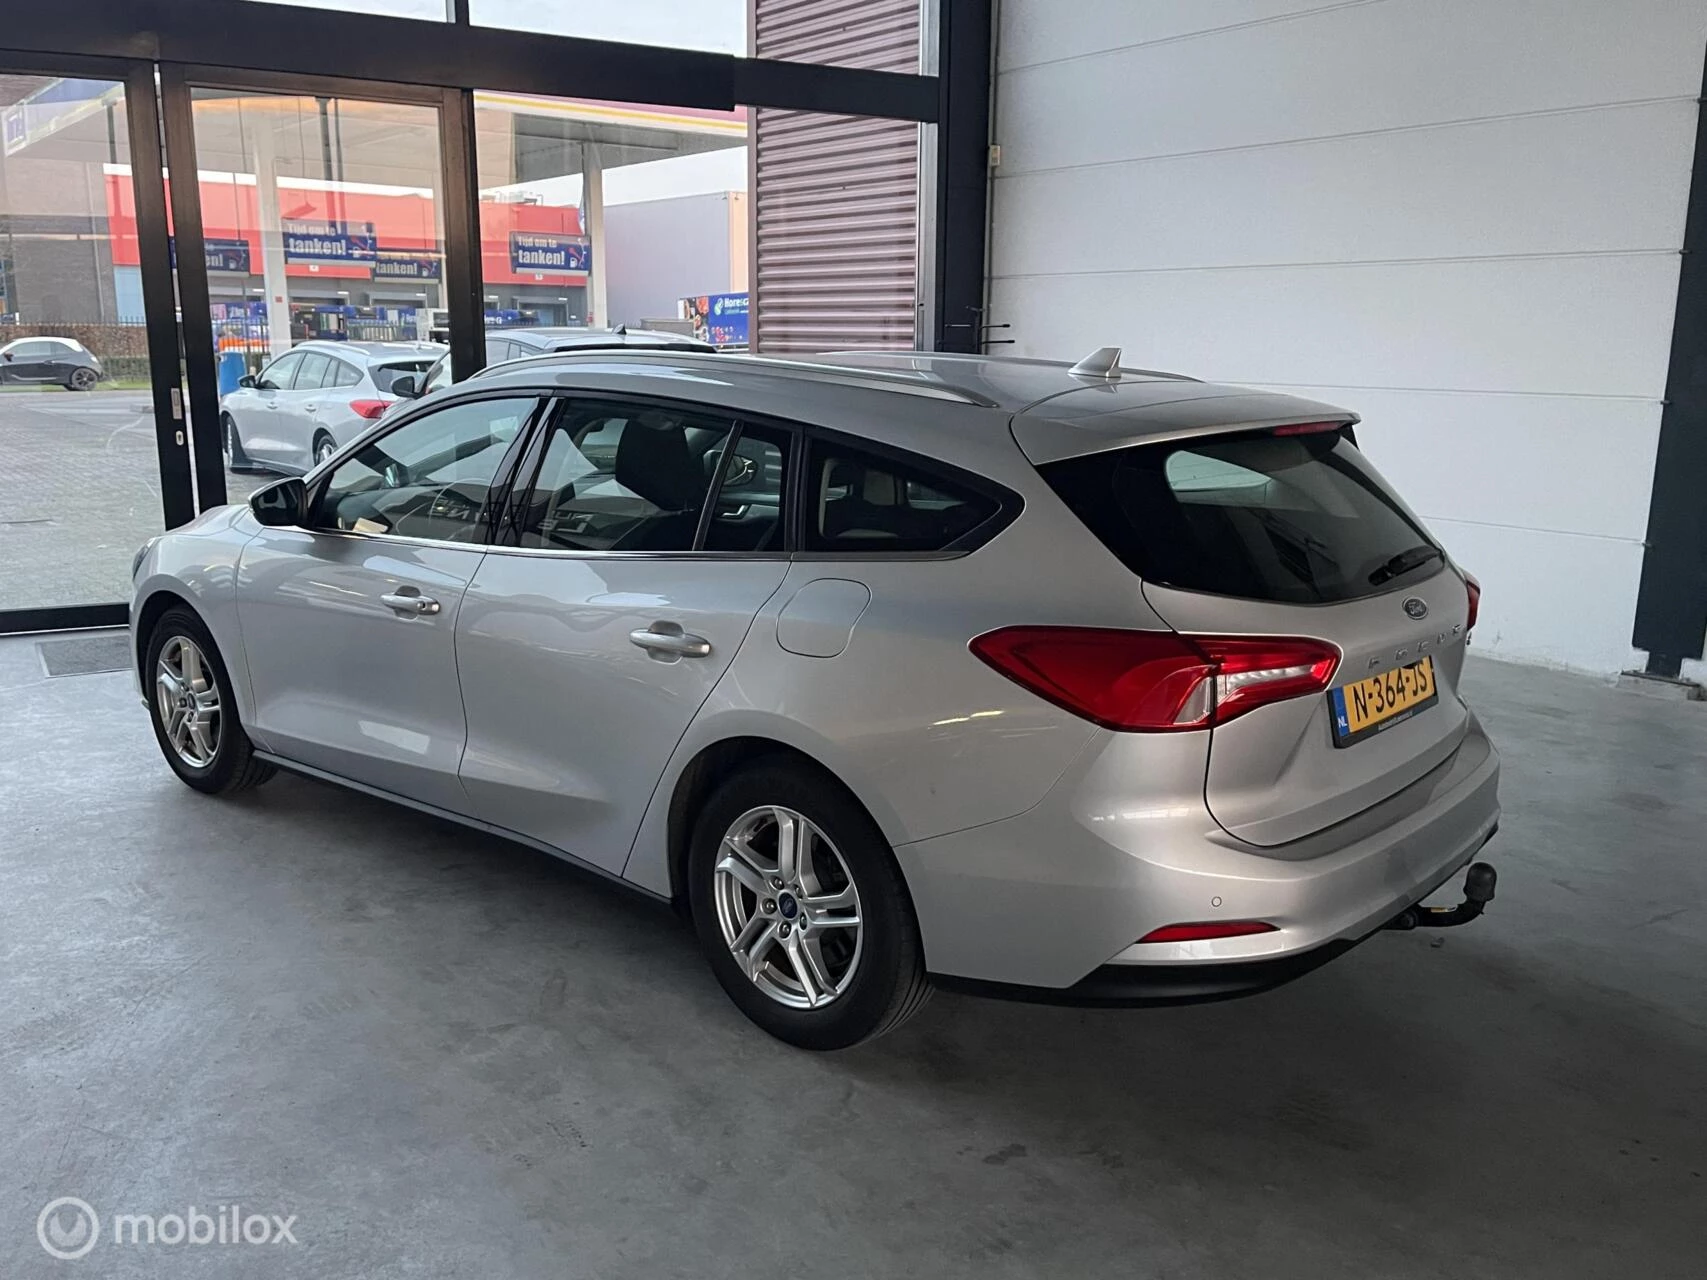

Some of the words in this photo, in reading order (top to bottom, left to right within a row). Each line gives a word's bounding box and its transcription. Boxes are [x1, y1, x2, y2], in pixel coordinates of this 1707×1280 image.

[289, 237, 346, 255] tanken!
[518, 249, 565, 265] tanken!
[376, 261, 418, 275] tanken!
[1353, 663, 1427, 722] N-364-JS
[1337, 715, 1348, 729] NL
